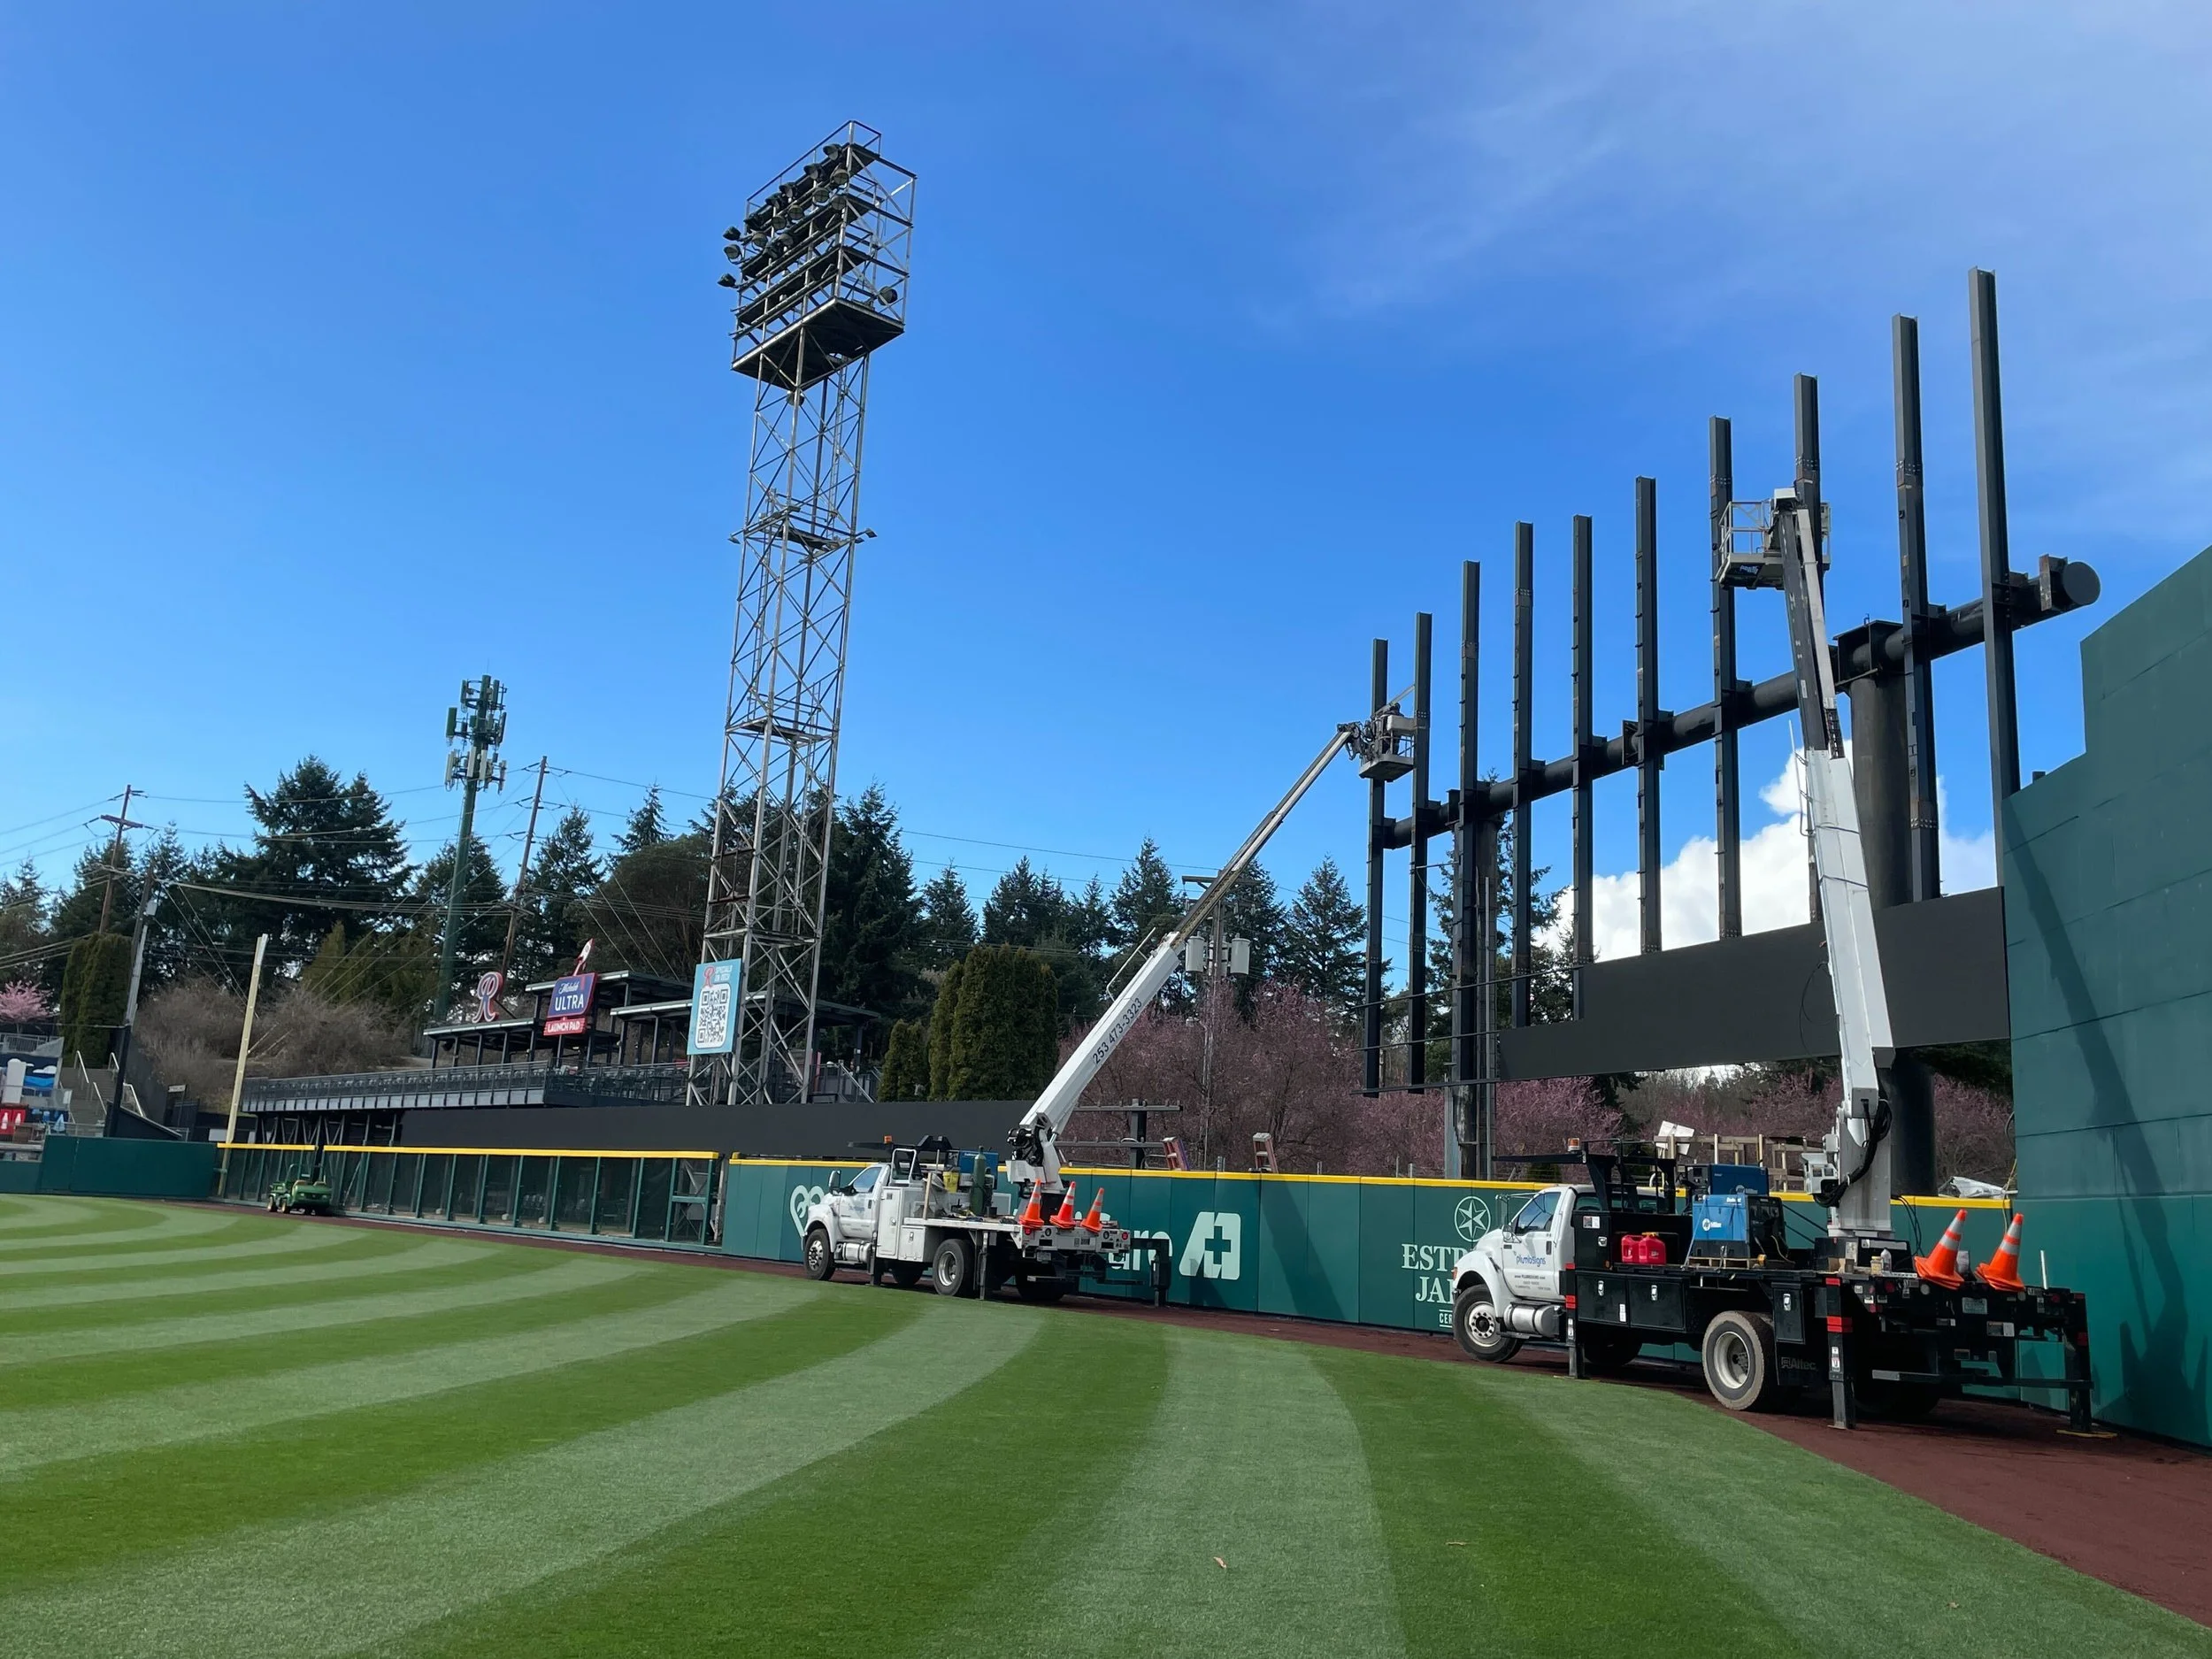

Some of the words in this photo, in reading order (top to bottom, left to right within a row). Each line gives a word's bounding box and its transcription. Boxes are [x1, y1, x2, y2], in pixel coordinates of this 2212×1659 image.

[555, 995, 584, 1011] ULTRA
[548, 1022, 569, 1033] LAUNCH
[569, 1021, 580, 1031] PAD
[1093, 1042, 1109, 1064] 253
[1109, 997, 1142, 1043] 473-3323
